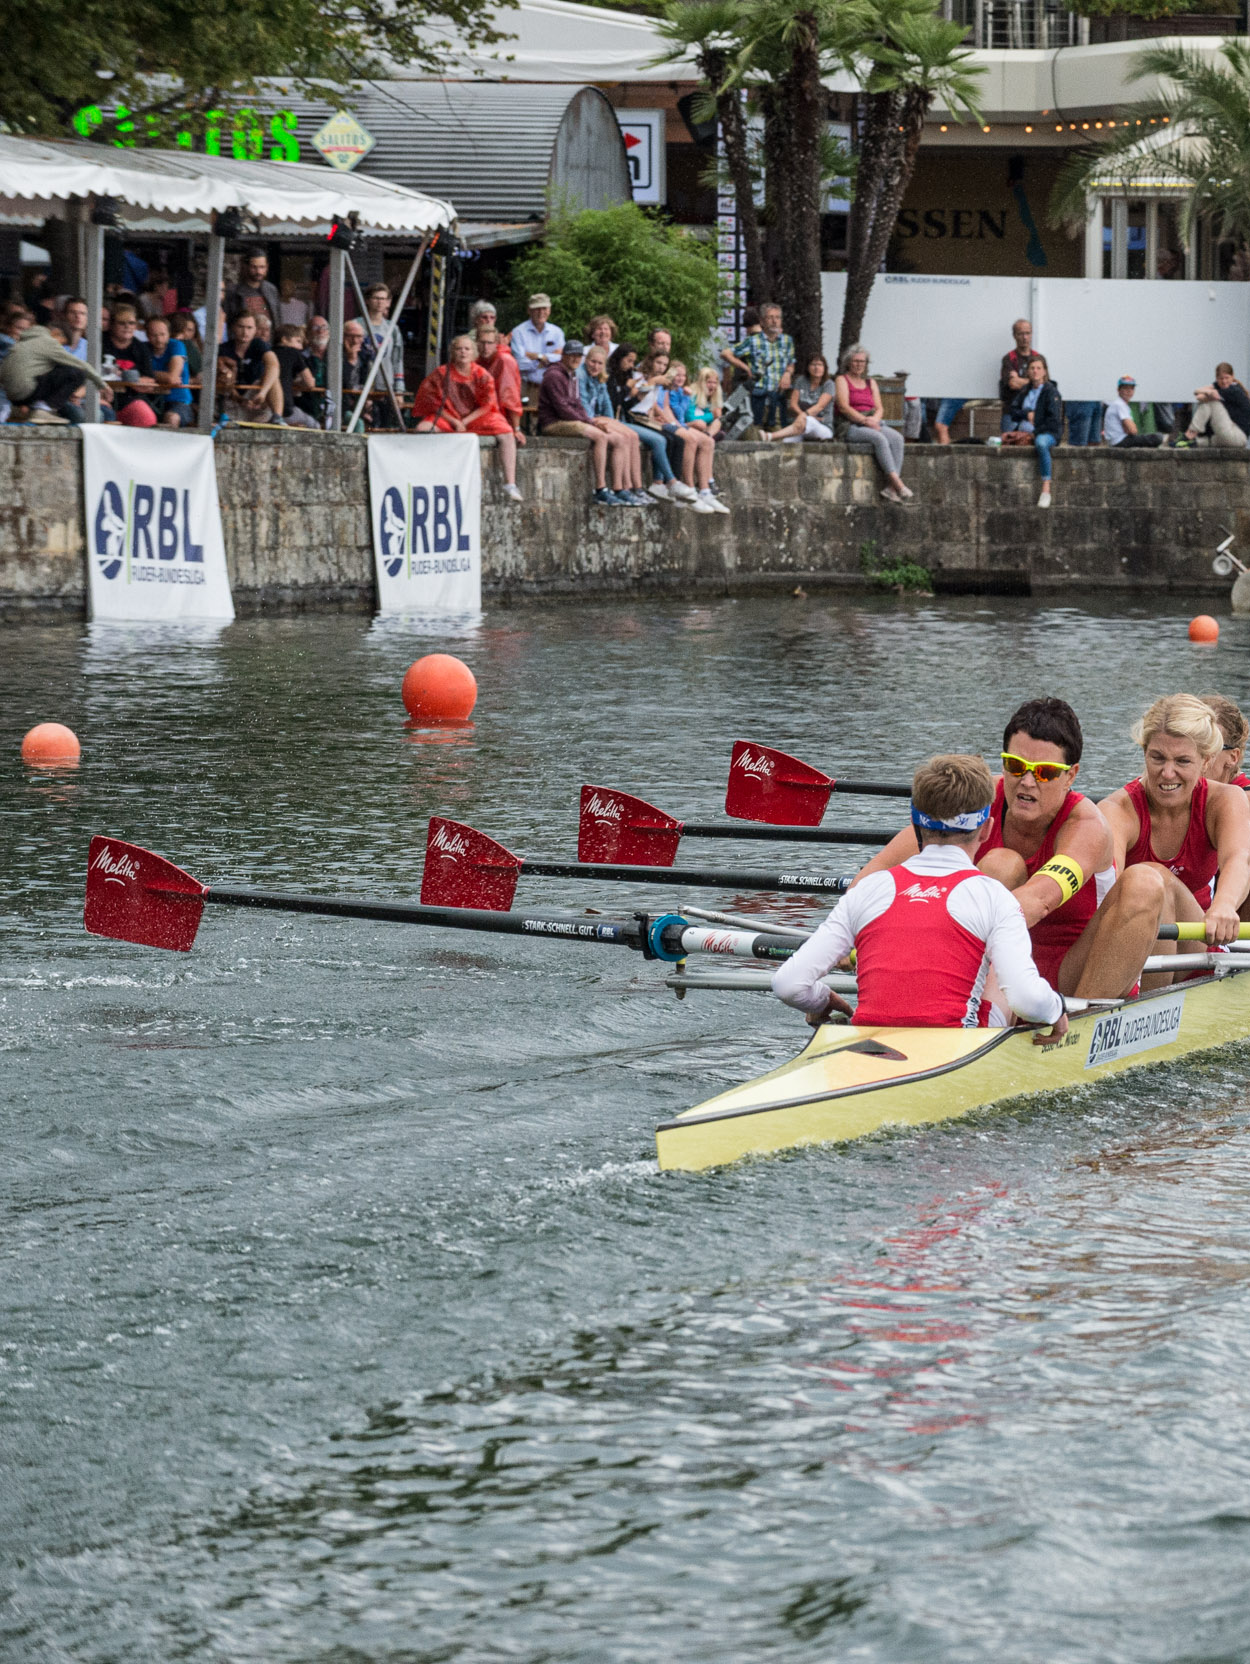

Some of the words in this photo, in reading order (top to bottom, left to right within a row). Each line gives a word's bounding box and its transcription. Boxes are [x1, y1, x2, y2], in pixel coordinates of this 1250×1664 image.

[132, 484, 205, 563] RBL
[412, 484, 470, 554] RBL
[732, 748, 772, 776] Melitta
[582, 792, 622, 821] Melitta
[429, 825, 467, 857] Melitta
[90, 845, 137, 880] Melitta
[898, 882, 942, 899] Melitta
[524, 920, 547, 933] STARK.
[547, 922, 578, 935] SCHNELL.
[578, 924, 594, 936] GUT.
[601, 926, 615, 936] RBL
[1101, 1016, 1123, 1049] RBL
[1121, 1005, 1182, 1046] RUDER-BUNDESLIGA
